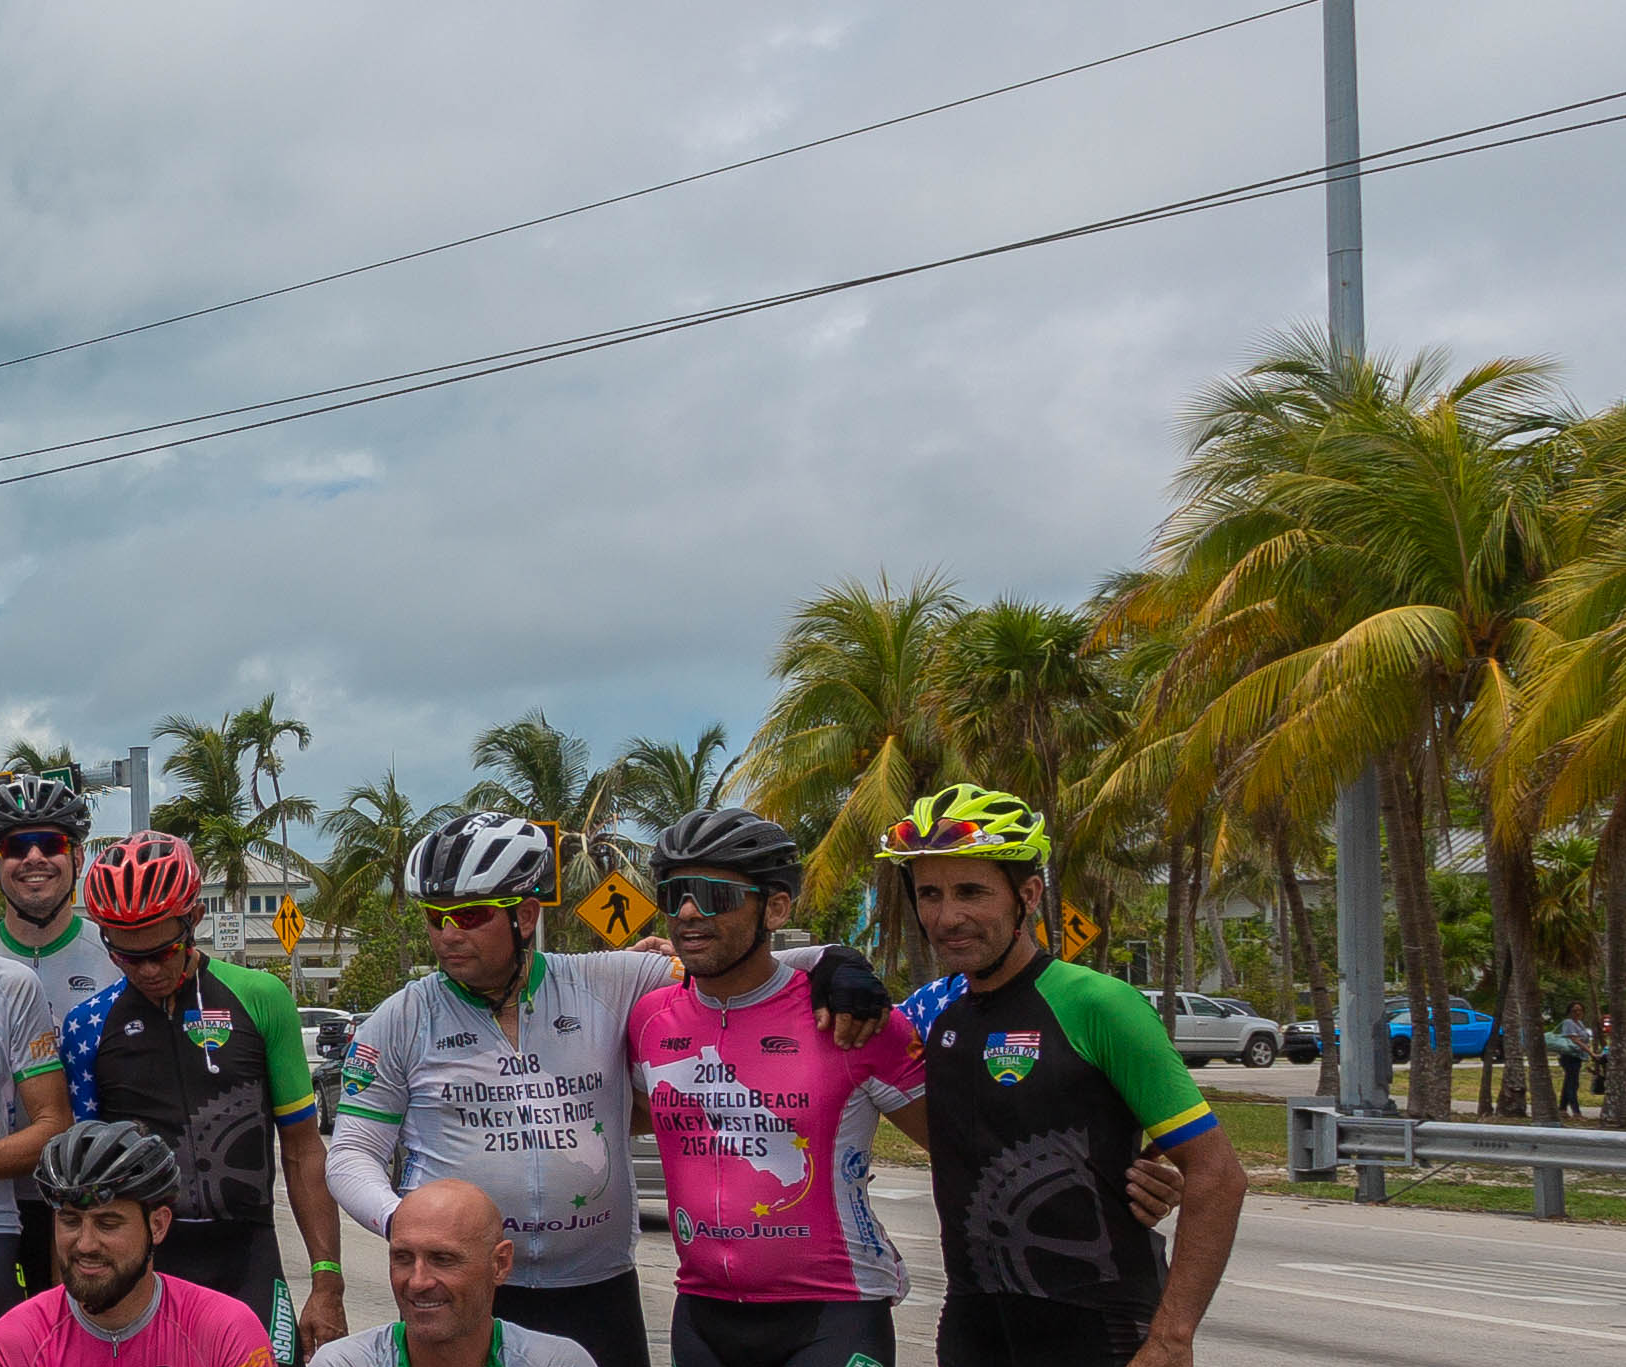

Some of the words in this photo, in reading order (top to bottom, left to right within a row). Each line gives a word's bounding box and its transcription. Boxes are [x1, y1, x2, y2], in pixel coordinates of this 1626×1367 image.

[435, 1032, 478, 1050] #NQSF
[659, 1037, 693, 1051] #NQSF
[497, 1053, 541, 1076] 2018
[996, 1057, 1021, 1066] PEDAL
[694, 1063, 737, 1084] 2018
[441, 1082, 474, 1102] 4TH
[475, 1082, 554, 1103] DEERFIELD
[555, 1072, 603, 1097] BEACH
[669, 1090, 746, 1109] DEERFIELD
[749, 1089, 810, 1109] BEACH
[455, 1107, 479, 1128] TO
[480, 1107, 514, 1128] KEY
[516, 1104, 561, 1126] WEST
[562, 1101, 595, 1123] RIDE
[656, 1113, 670, 1132] TO
[671, 1113, 704, 1132] KEY
[706, 1114, 752, 1132] WEST
[754, 1114, 797, 1133] RIDE
[484, 1131, 519, 1152] 215
[522, 1128, 578, 1150] MILES
[680, 1136, 706, 1156] 215
[709, 1137, 768, 1158] MILES
